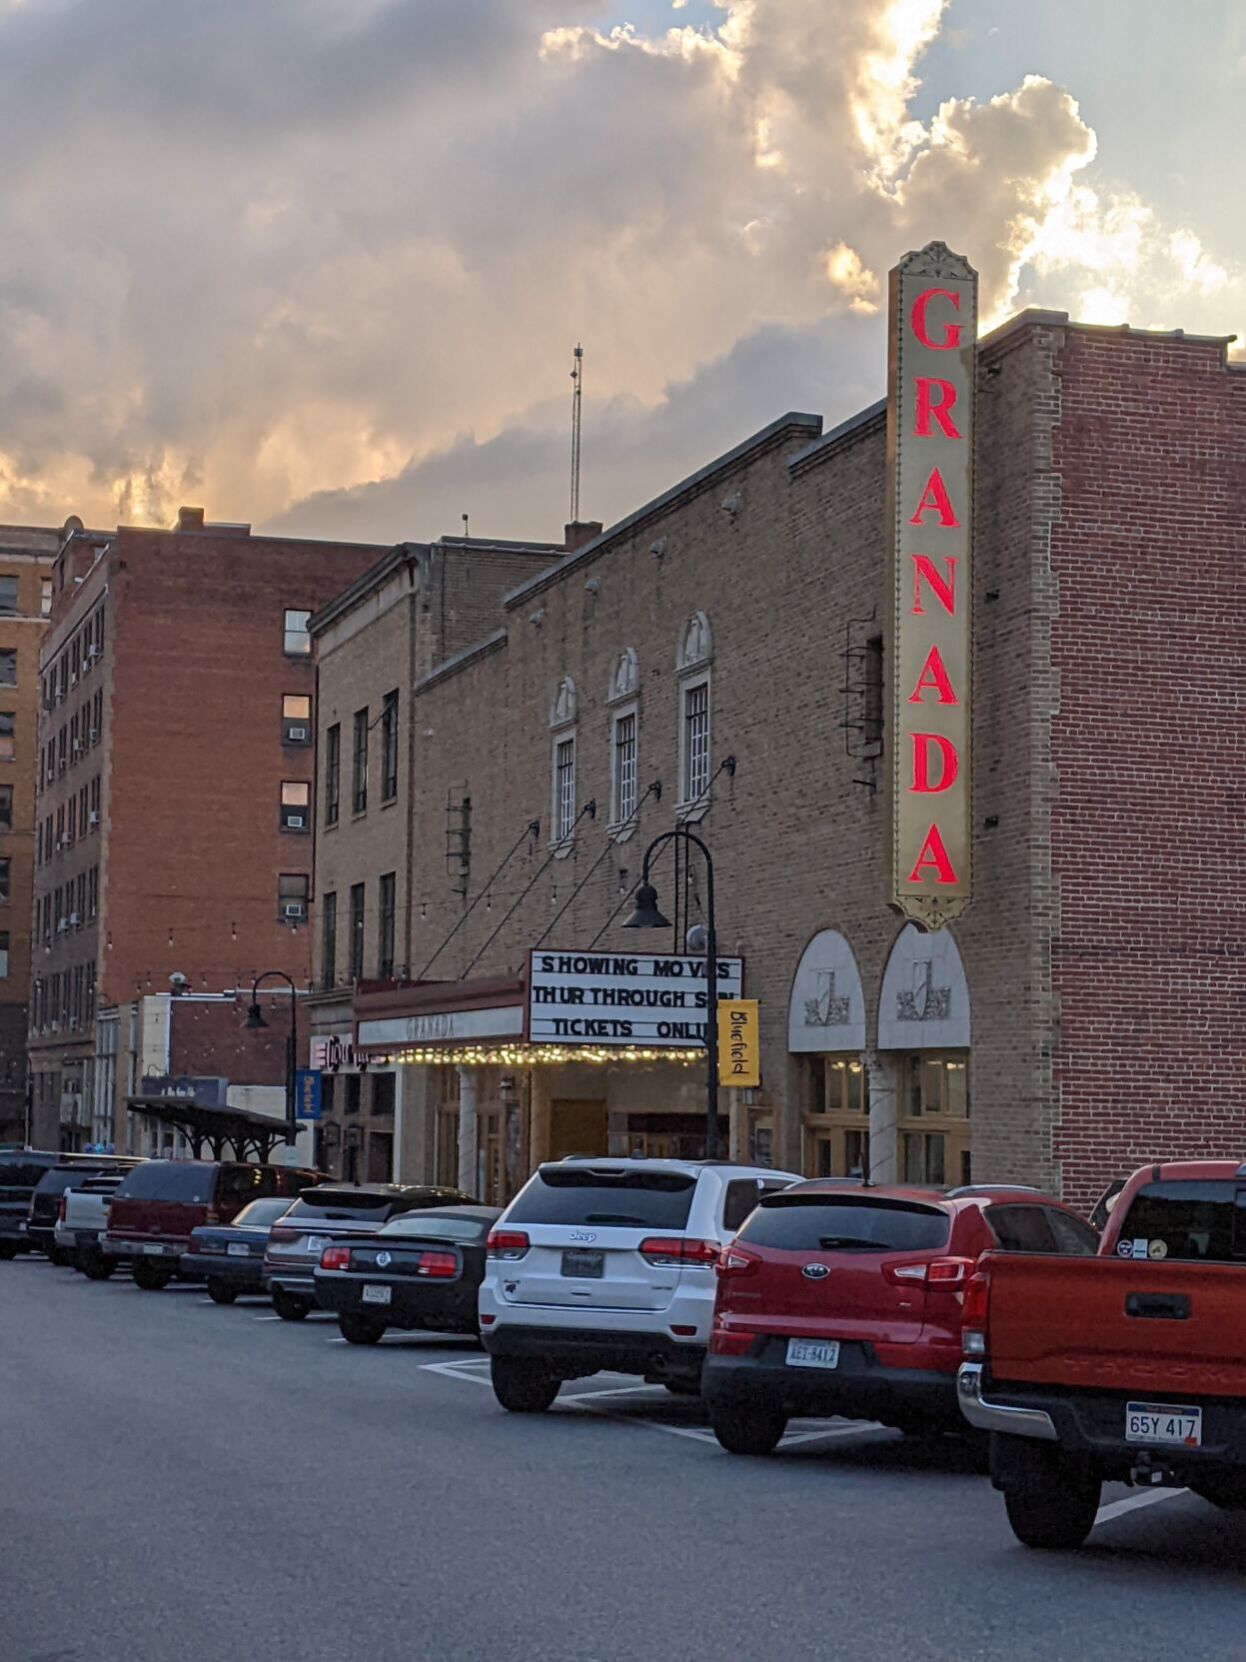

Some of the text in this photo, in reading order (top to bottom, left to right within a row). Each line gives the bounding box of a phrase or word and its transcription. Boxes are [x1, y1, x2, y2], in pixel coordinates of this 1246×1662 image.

[909, 288, 962, 885] GRANADA
[541, 955, 638, 976] SHOWING
[533, 985, 585, 1005] THUR
[590, 988, 685, 1008] THROUGH
[552, 1018, 633, 1037] TICKETS
[730, 1011, 749, 1075] Bluefield
[569, 1230, 597, 1243] Jeep
[1131, 1416, 1196, 1437] 65Y 417
